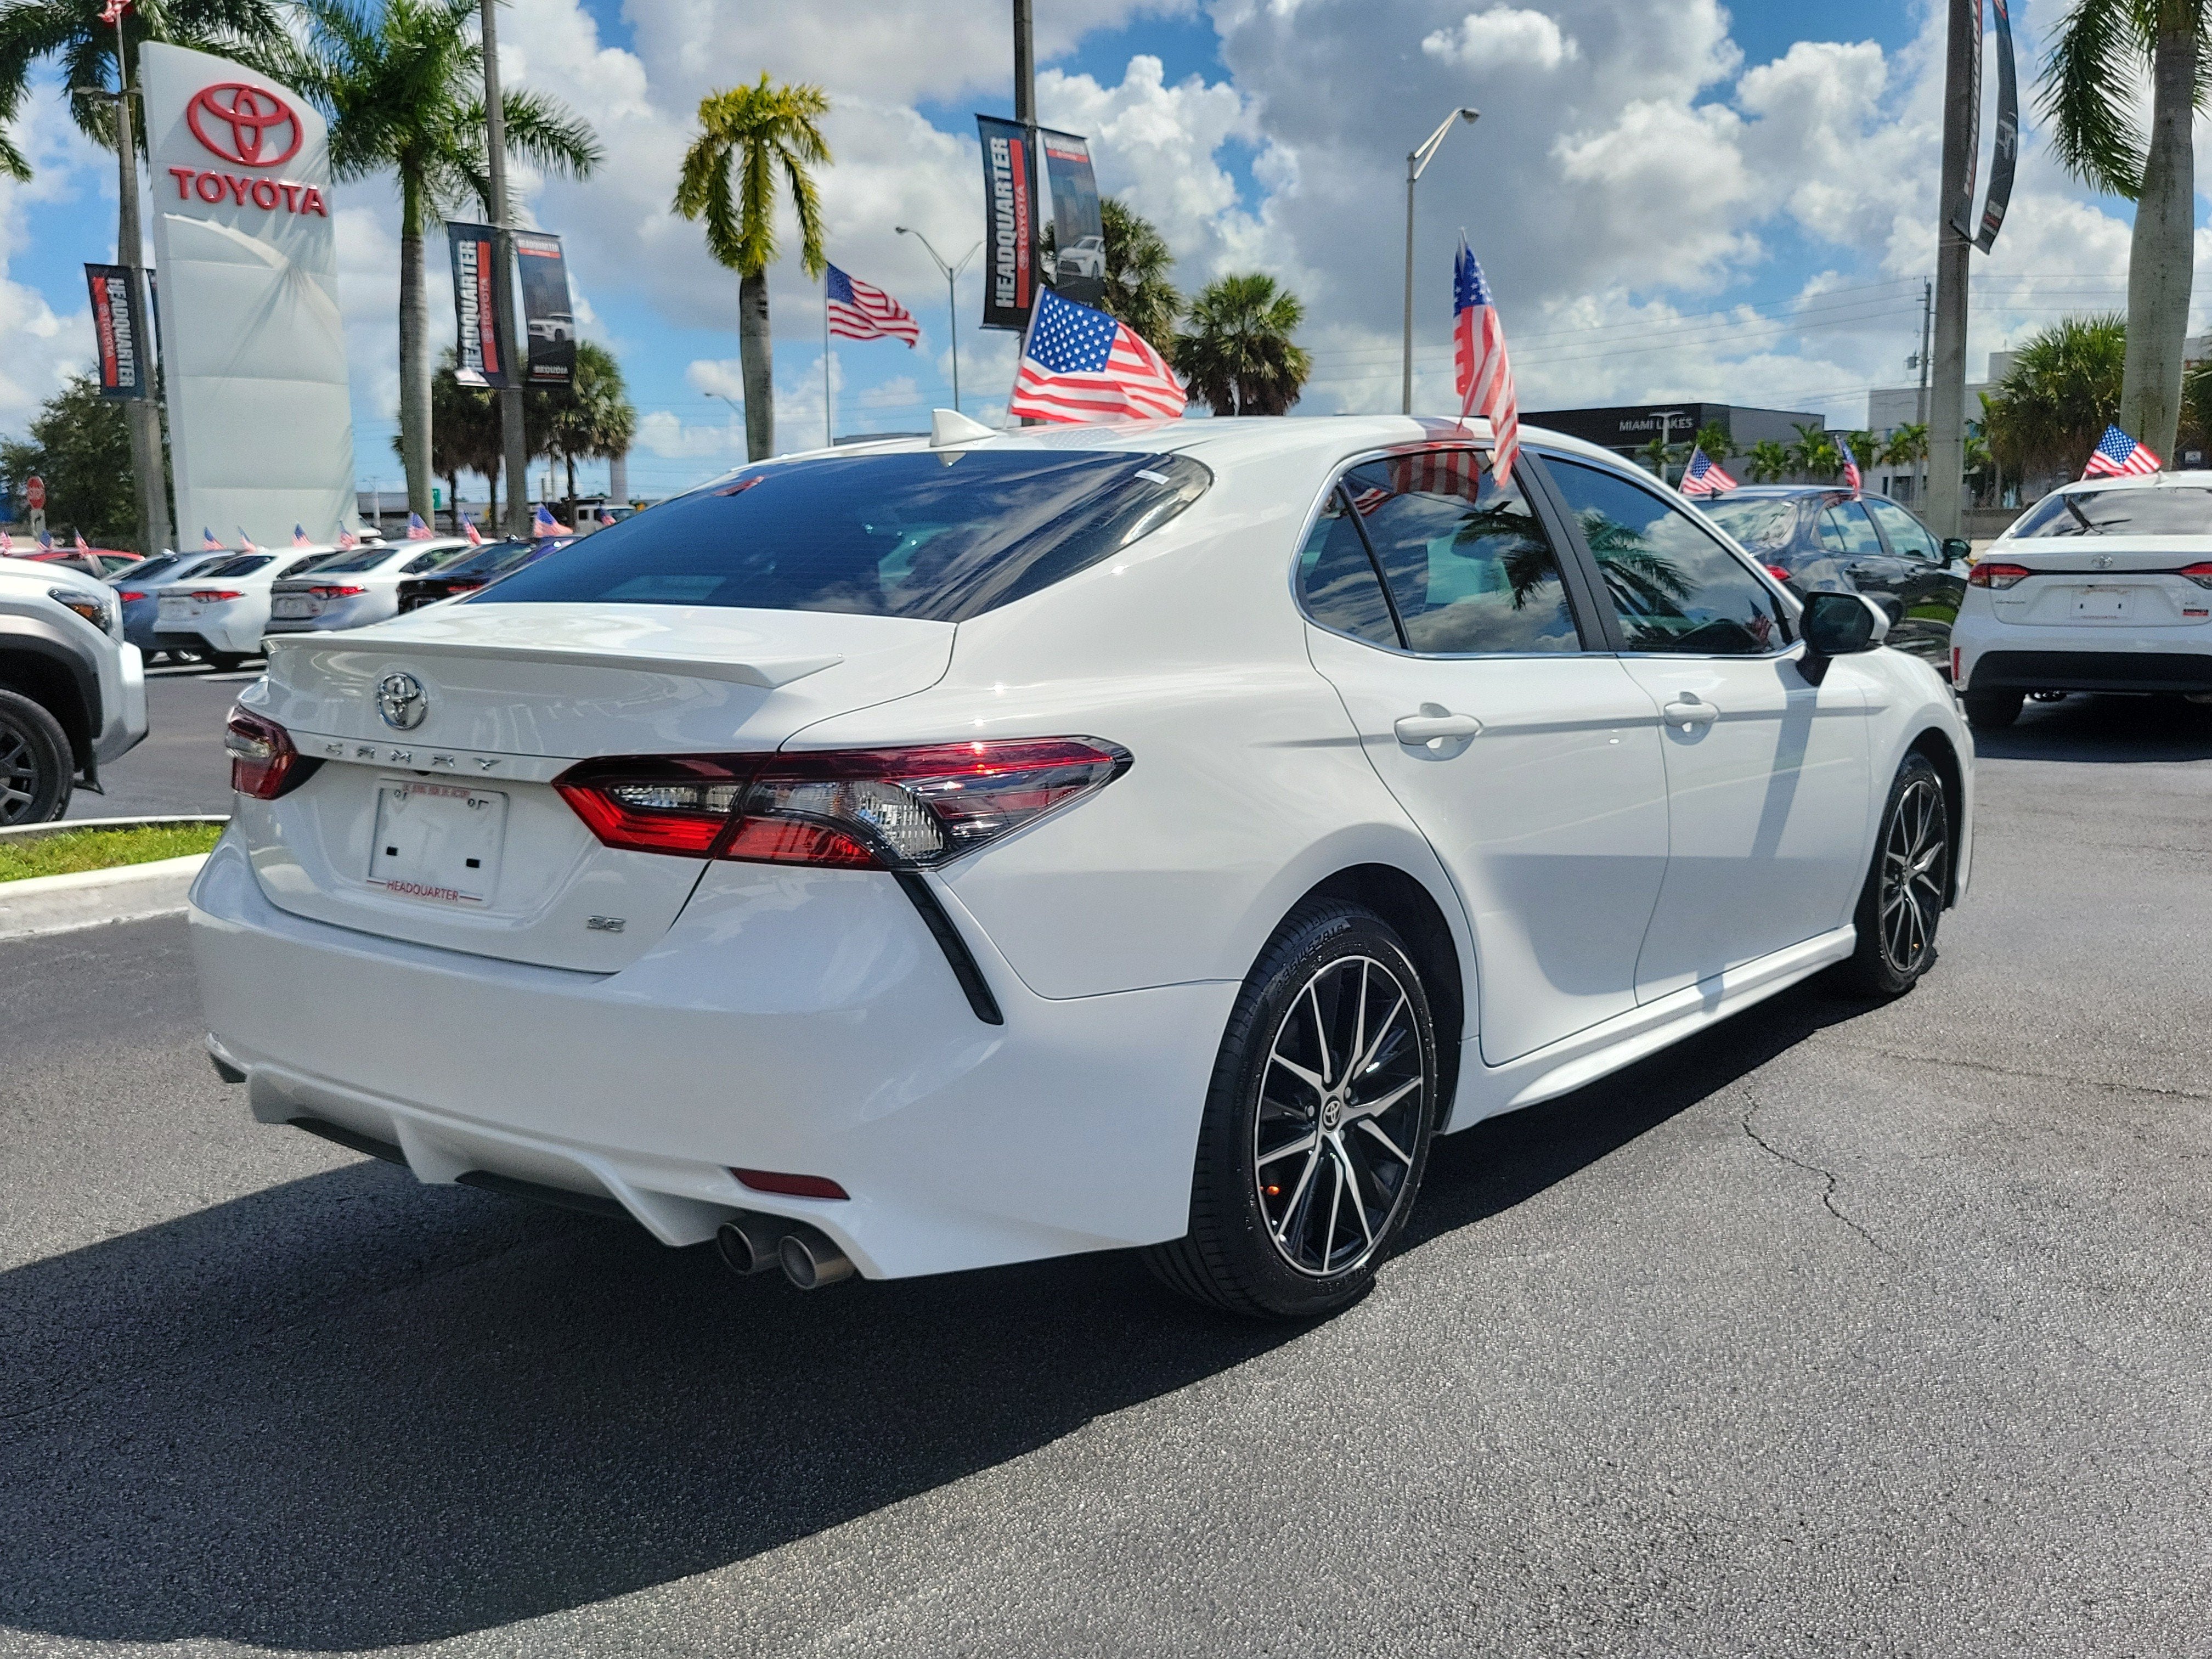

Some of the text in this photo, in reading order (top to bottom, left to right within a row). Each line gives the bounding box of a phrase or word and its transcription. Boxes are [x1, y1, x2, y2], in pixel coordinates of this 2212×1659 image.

[170, 167, 328, 217] TOYOTA
[1016, 185, 1028, 246] TOYOTA
[990, 138, 1017, 308] HEADQUARTER
[459, 240, 484, 373] HEADQUARTER
[478, 278, 491, 326] TOYOTA
[106, 278, 136, 387] HEADQUARTER
[1620, 417, 1693, 431] MIAMI LKES
[326, 742, 501, 770] CAMRY
[387, 880, 459, 901] HEADQUARTER
[587, 915, 625, 932] SE
